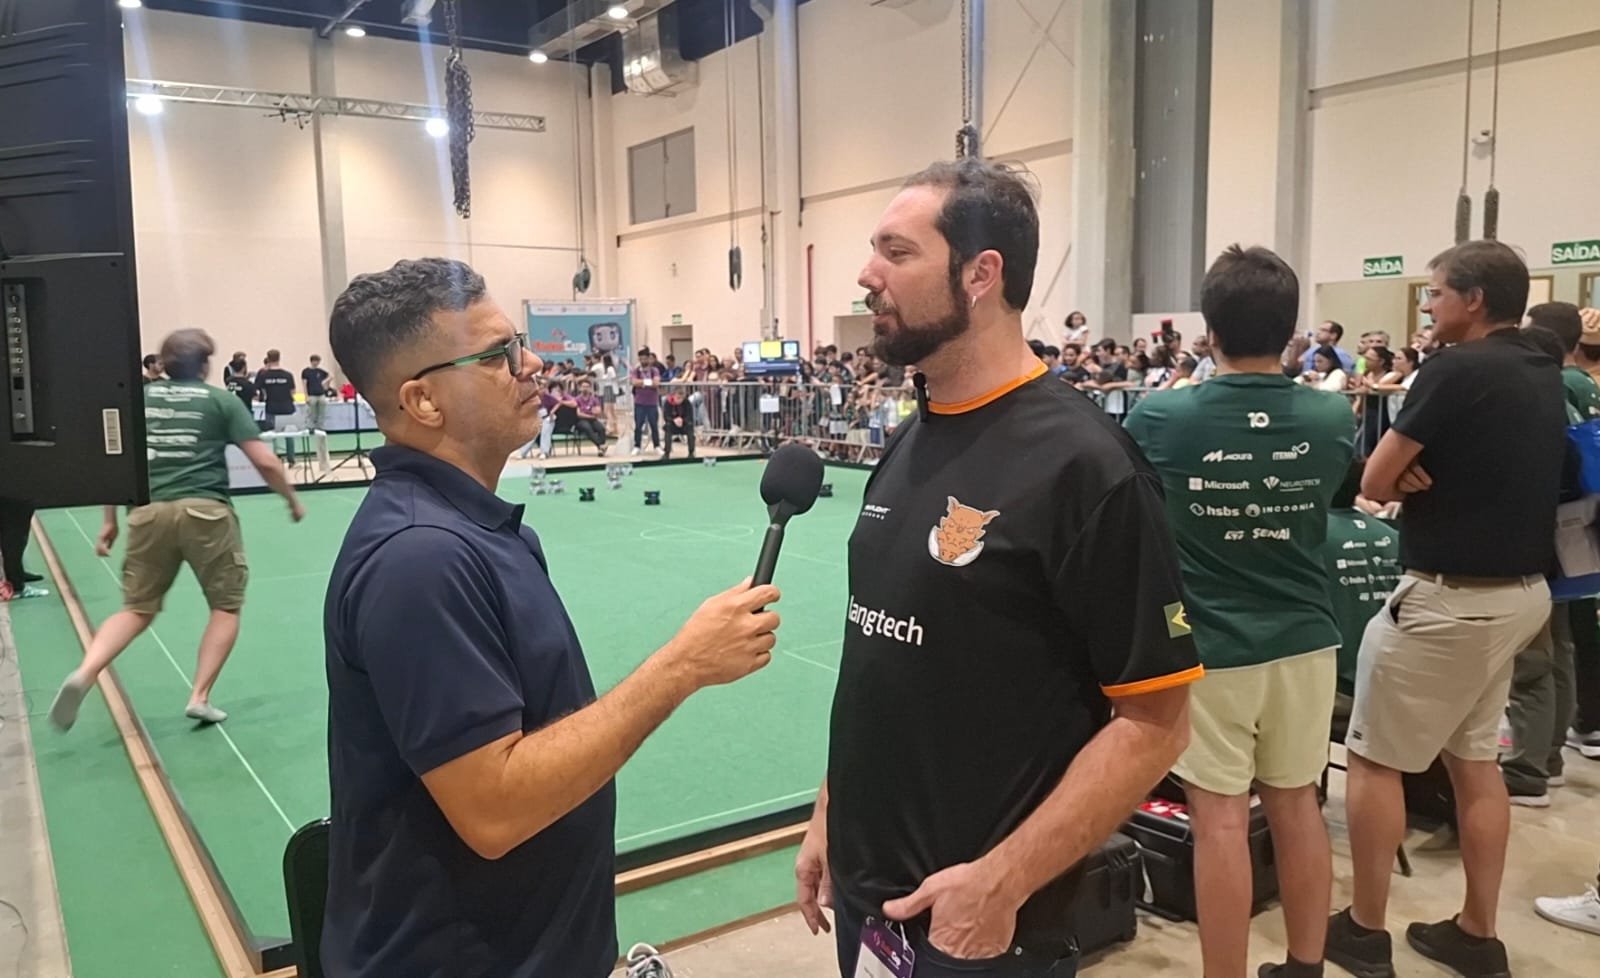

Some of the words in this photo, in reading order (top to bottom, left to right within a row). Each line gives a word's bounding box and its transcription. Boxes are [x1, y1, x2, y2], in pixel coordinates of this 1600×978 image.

[1552, 242, 1600, 261] SAÍDA
[1363, 258, 1402, 275] SAÍDA
[1204, 480, 1250, 490] Microsoft
[1206, 505, 1240, 517] hsbs
[1252, 527, 1290, 540] SENAI
